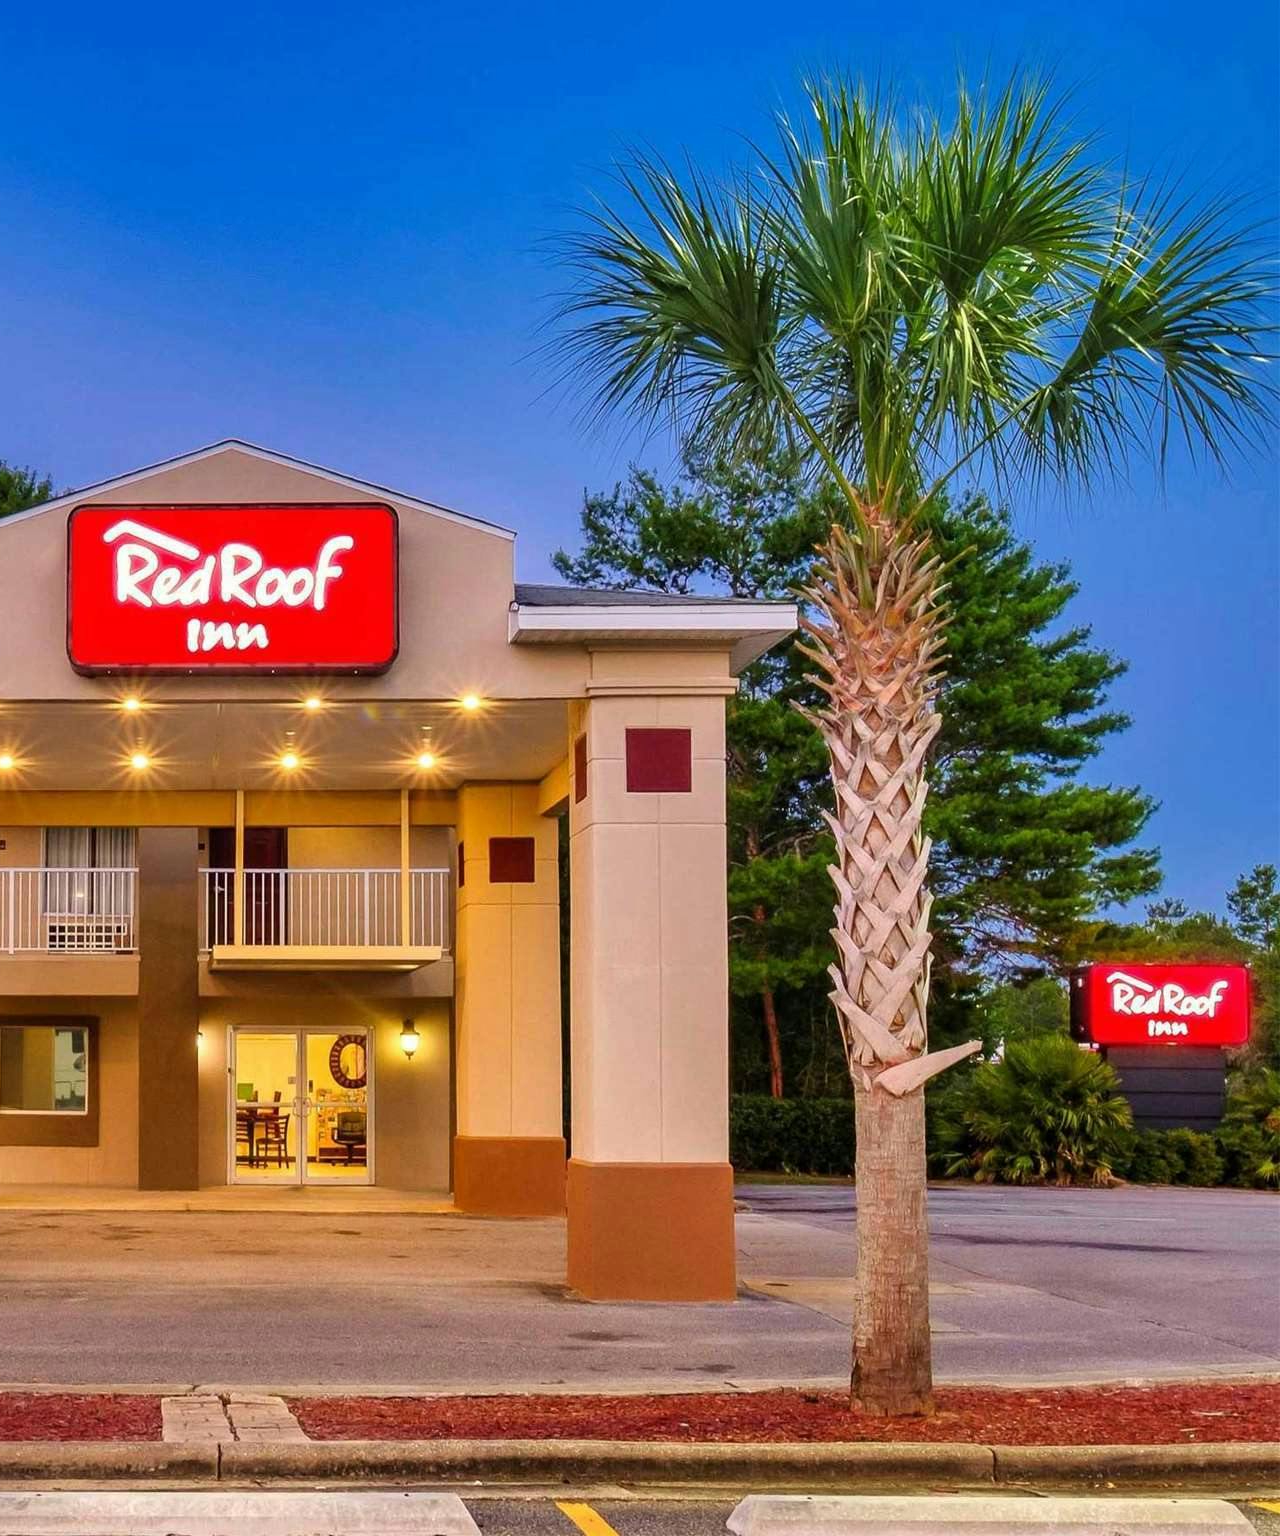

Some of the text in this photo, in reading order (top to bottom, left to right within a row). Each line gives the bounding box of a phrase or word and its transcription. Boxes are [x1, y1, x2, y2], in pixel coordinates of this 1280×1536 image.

[116, 535, 354, 610] Red Roof
[187, 618, 269, 652] Inn
[1148, 1019, 1188, 1036] Inn
